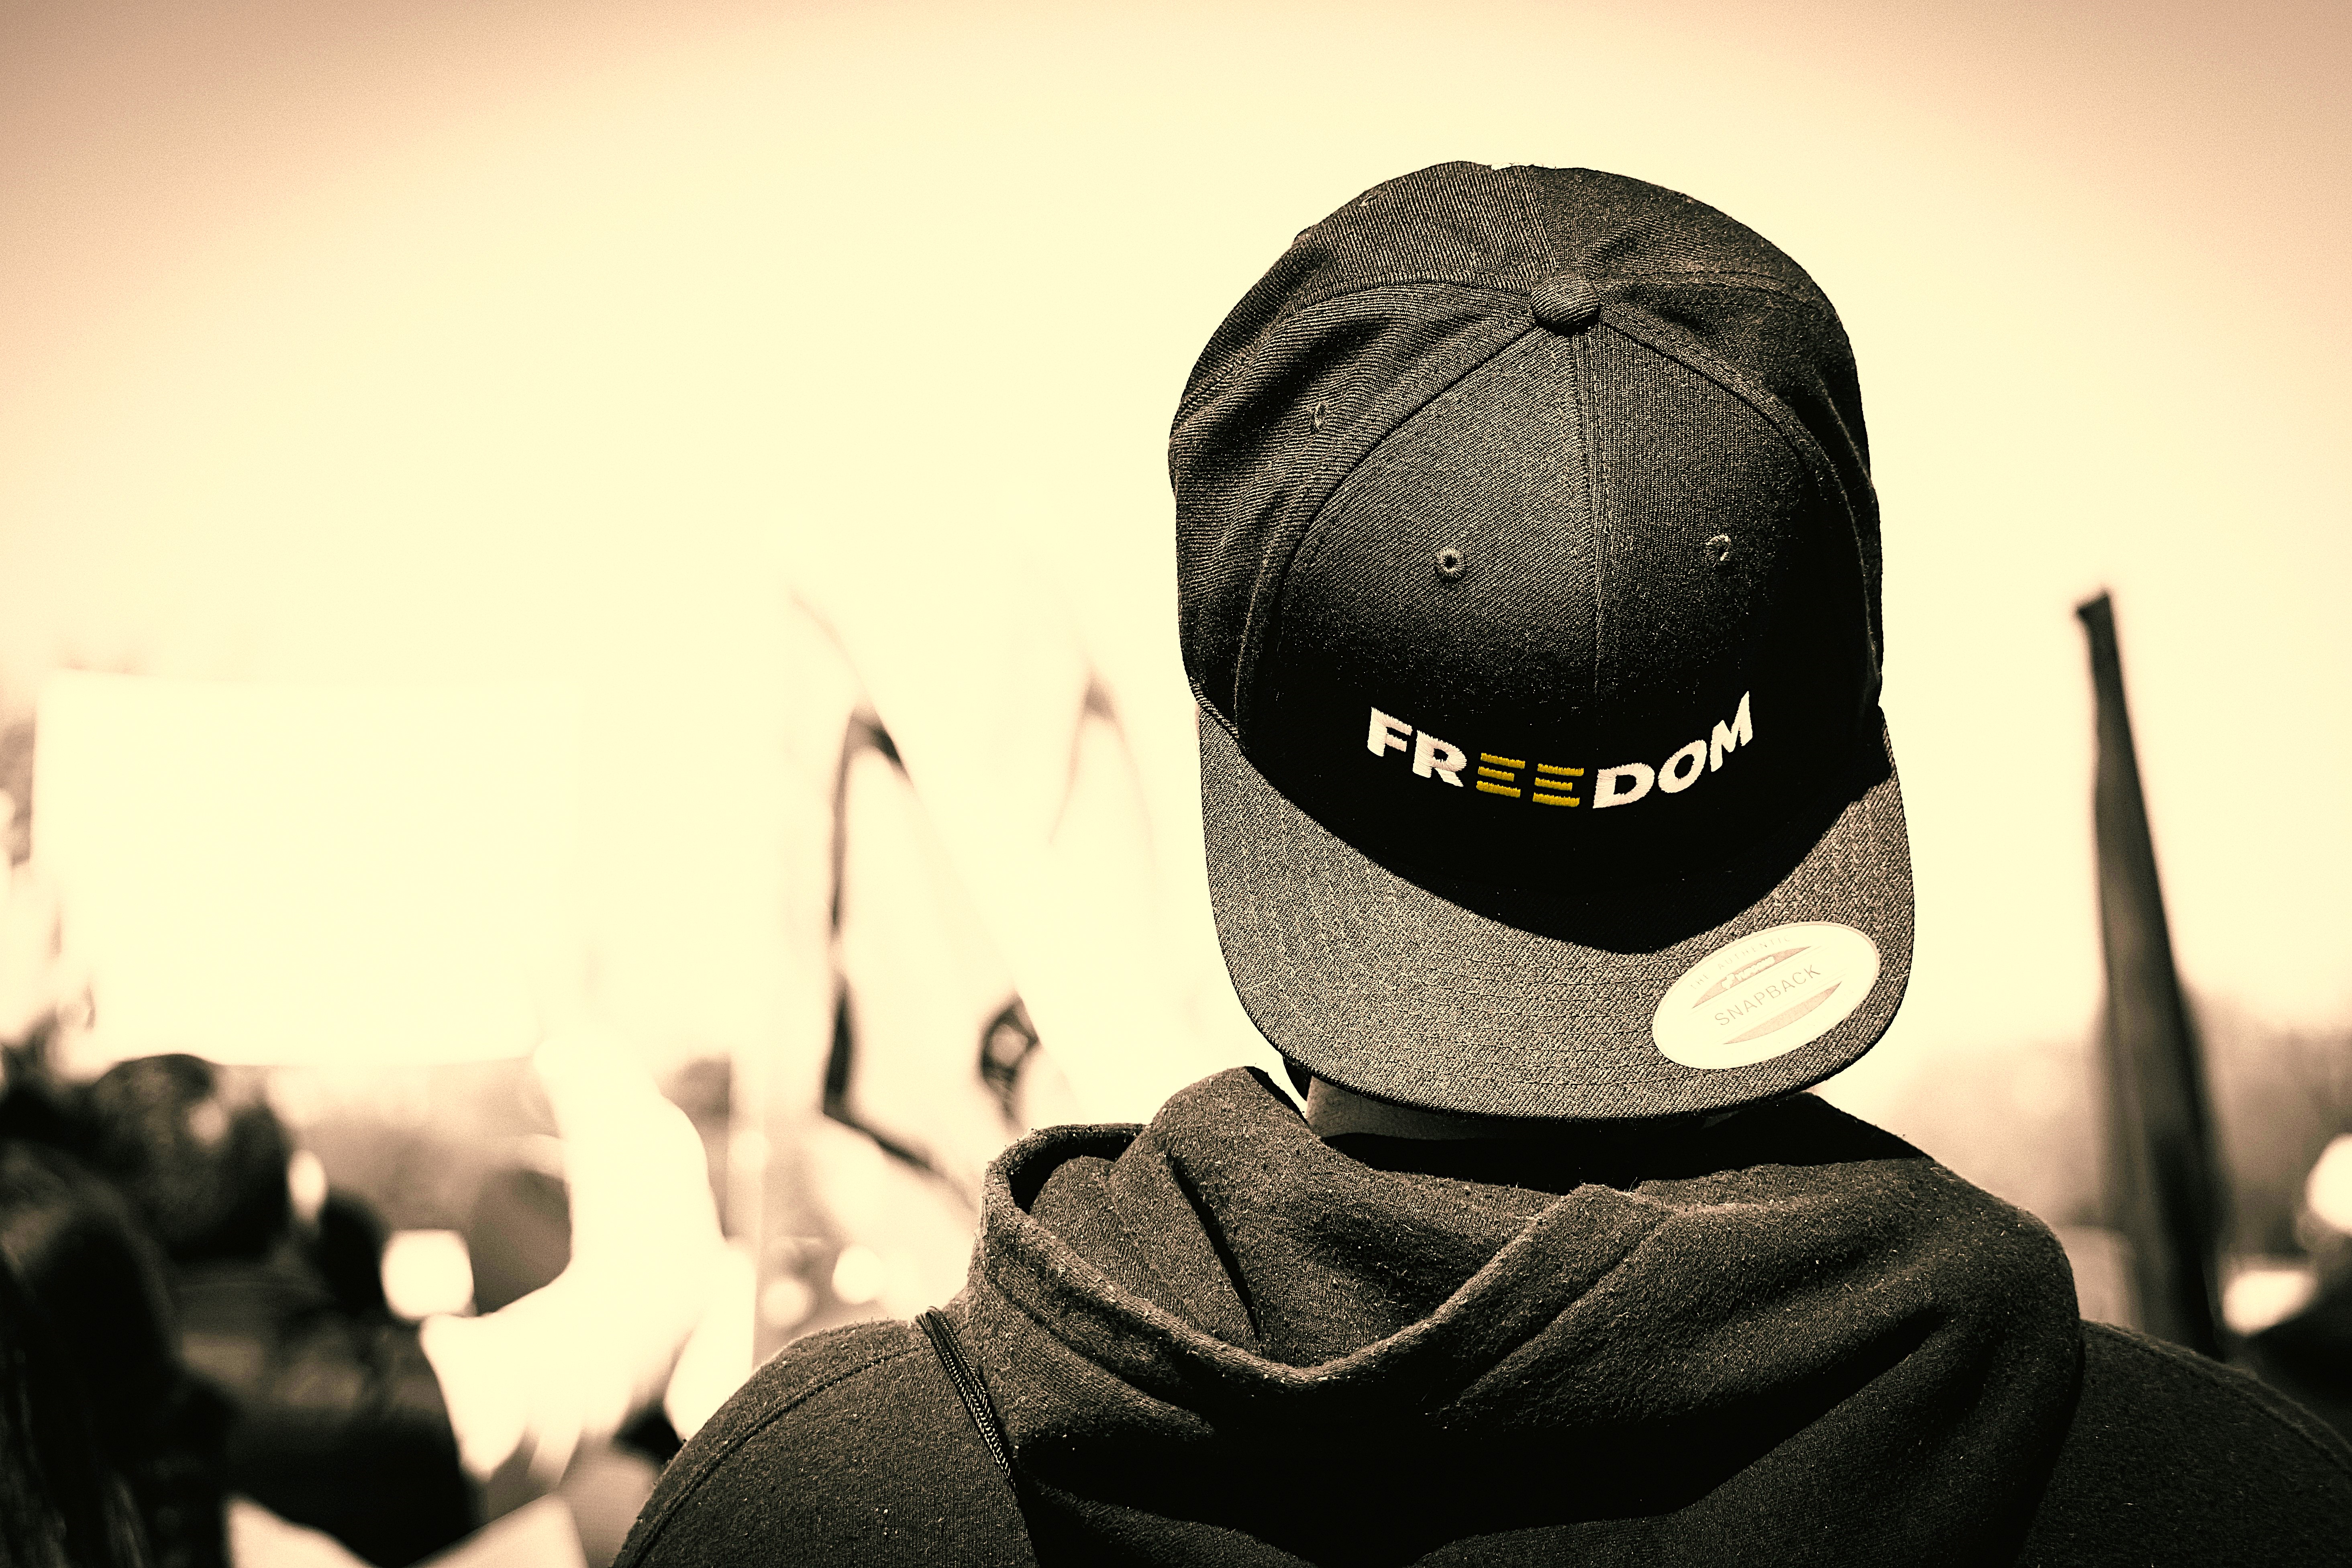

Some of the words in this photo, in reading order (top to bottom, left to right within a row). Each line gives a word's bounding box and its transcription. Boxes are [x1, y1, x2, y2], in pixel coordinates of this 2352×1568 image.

[1367, 691, 1753, 808] FREEDOM
[1690, 973, 1710, 990] THE
[1718, 934, 1792, 970] AUTHENTIC
[1715, 964, 1821, 1025] SNAPBACK
